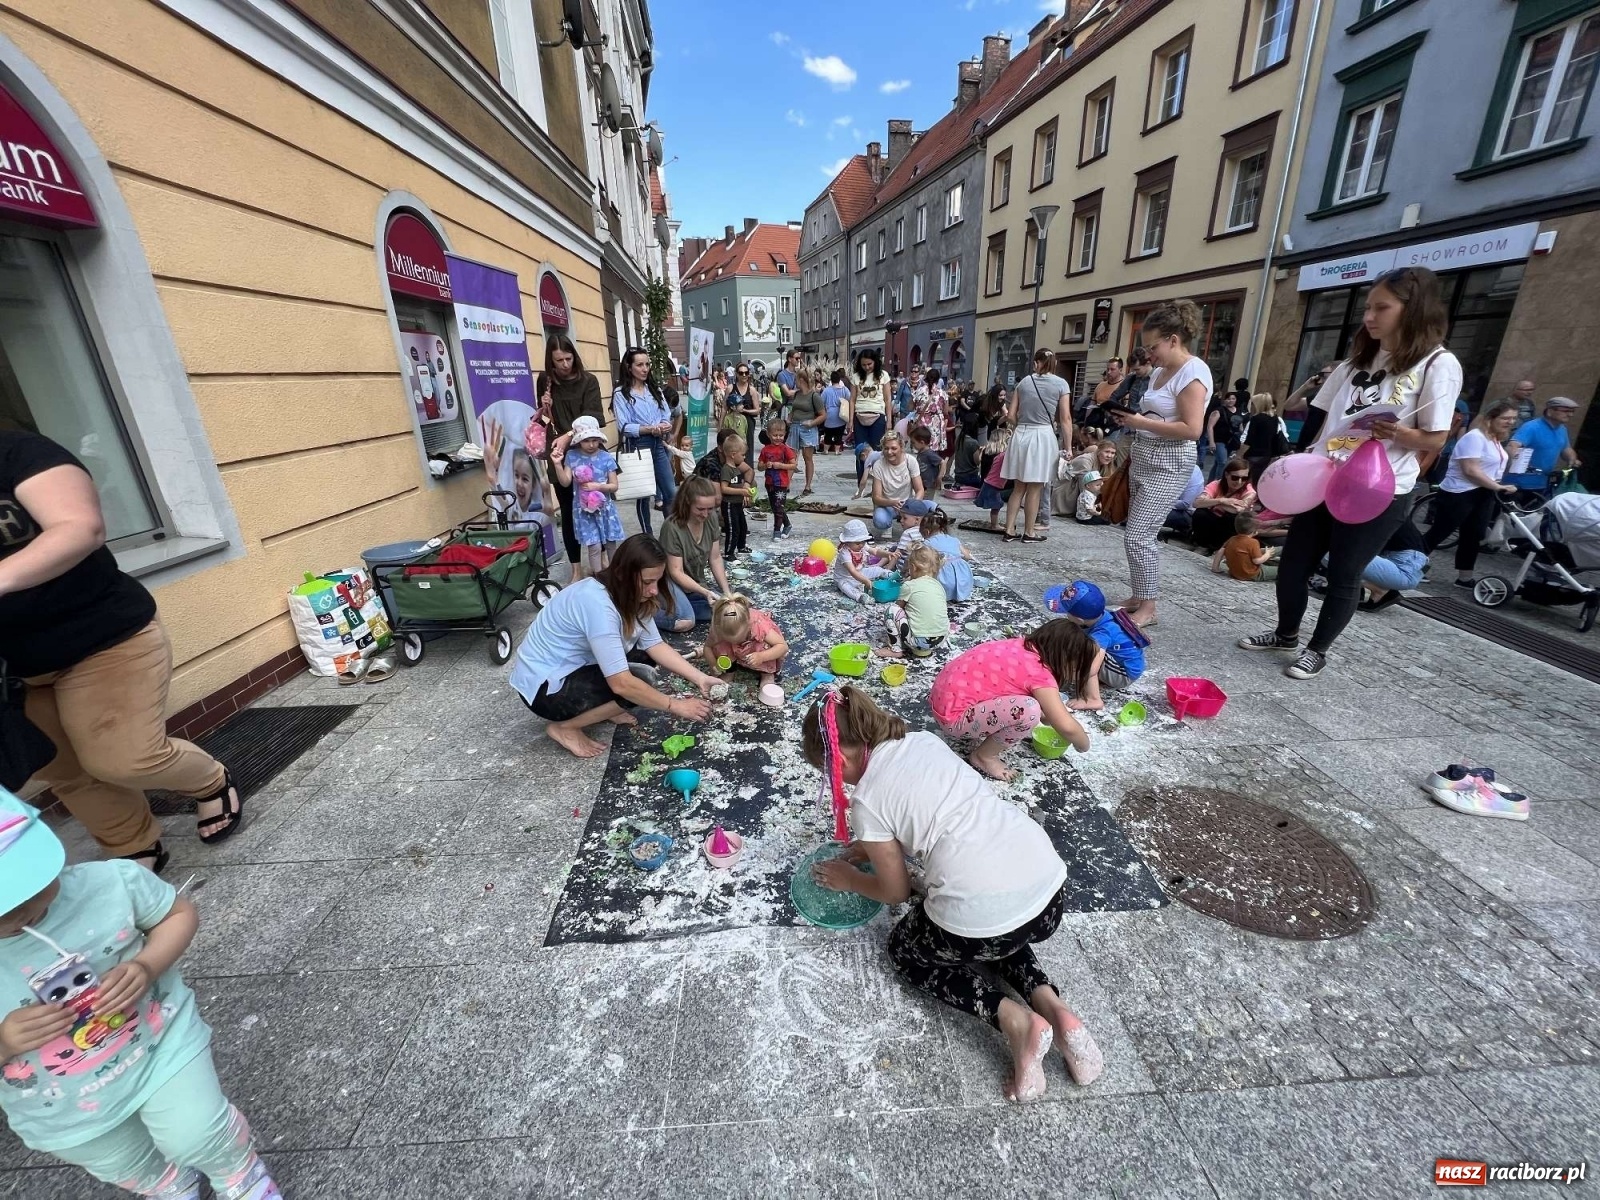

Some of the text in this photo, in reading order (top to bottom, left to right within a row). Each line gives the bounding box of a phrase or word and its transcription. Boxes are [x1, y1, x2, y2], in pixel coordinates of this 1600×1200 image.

[0, 179, 49, 206] ank
[1410, 238, 1509, 265] SHOWROOM
[388, 245, 451, 287] Millennium
[1320, 260, 1368, 277] DROGERIA
[78, 1046, 144, 1098] JUNGLE
[95, 1055, 120, 1077] MY
